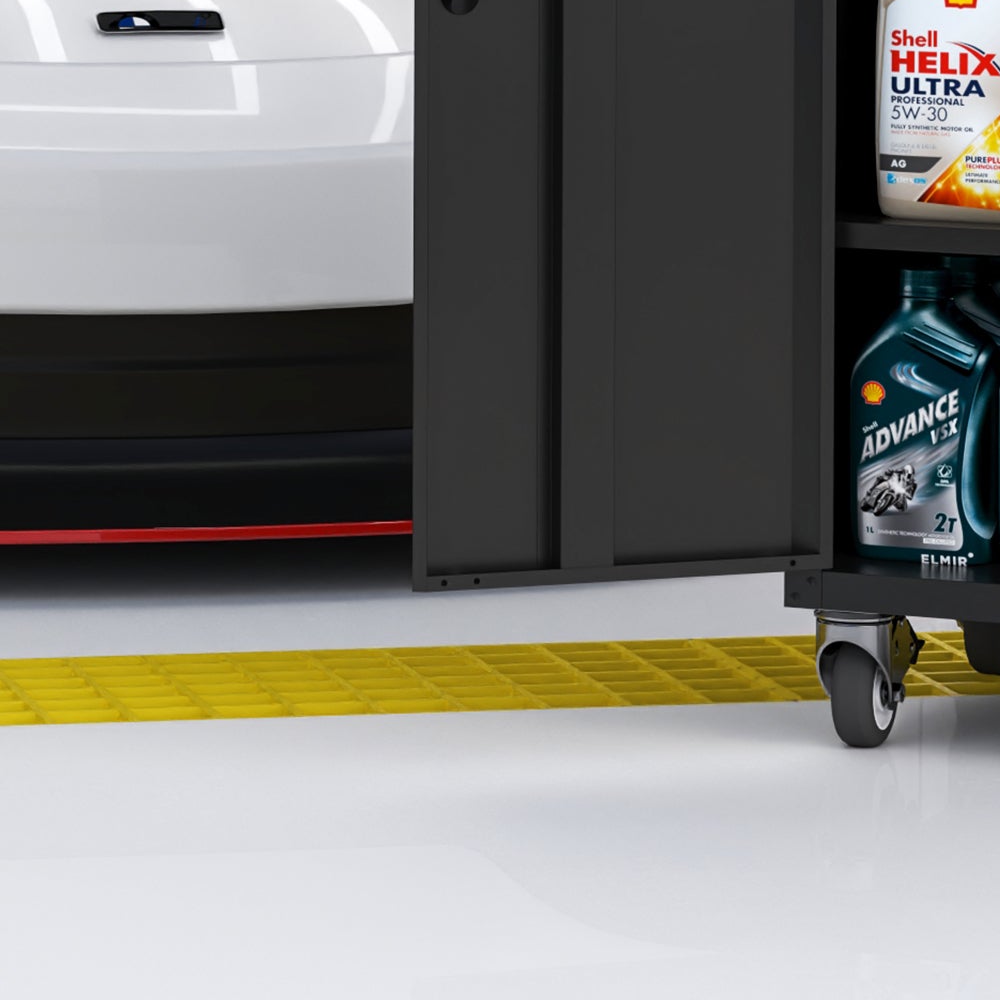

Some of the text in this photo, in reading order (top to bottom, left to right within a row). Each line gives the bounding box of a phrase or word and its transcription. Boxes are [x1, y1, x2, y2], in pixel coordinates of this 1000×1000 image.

[890, 29, 938, 48] Shell
[891, 76, 986, 98] ULTRA
[890, 95, 965, 107] PROFESSIONAL
[890, 106, 948, 122] 5W-30
[890, 159, 907, 169] AG
[860, 388, 960, 465] ADVANCE
[862, 420, 879, 434] Shell
[929, 417, 959, 446] VSX
[933, 512, 958, 534] 2T
[920, 553, 968, 567] ELMIR
